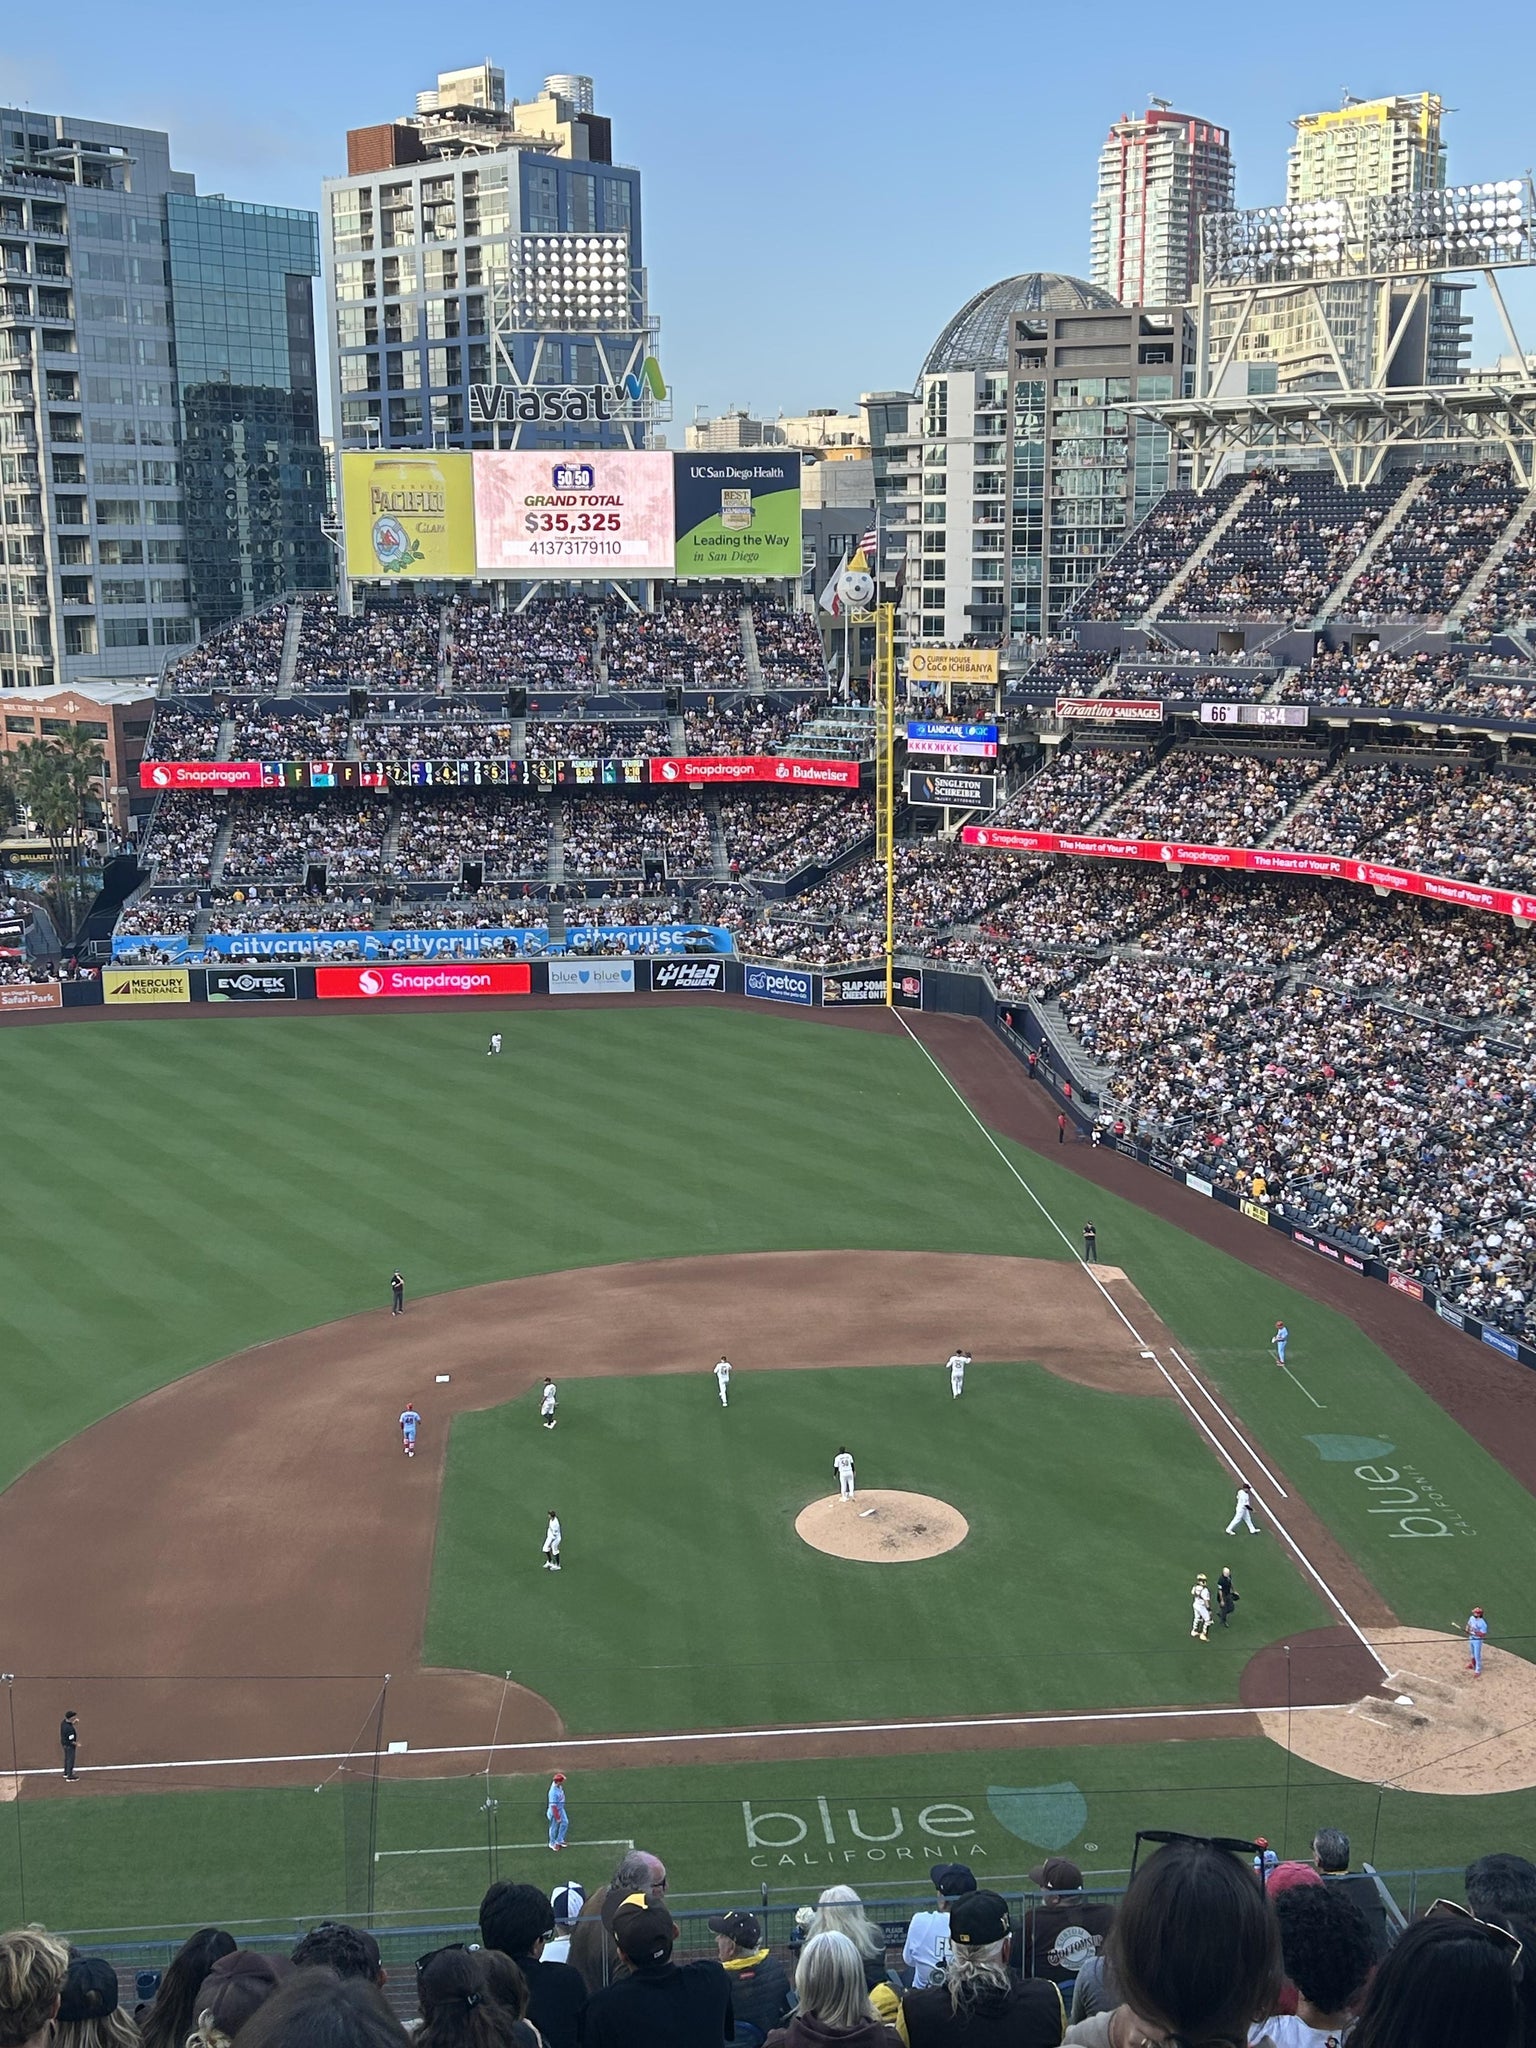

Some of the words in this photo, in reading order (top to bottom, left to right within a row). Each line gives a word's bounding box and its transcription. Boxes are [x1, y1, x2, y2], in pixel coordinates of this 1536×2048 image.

[474, 384, 611, 421] Viasat
[690, 466, 706, 478] UC
[707, 467, 725, 478] San
[726, 467, 752, 480] Diego
[753, 467, 784, 478] Health
[524, 496, 577, 506] GRAND
[580, 496, 624, 506] TOTAL
[724, 491, 748, 500] BEST
[525, 512, 621, 534] $35,325
[529, 541, 622, 555] 41373179110
[694, 535, 741, 548] Leading
[743, 535, 762, 545] the
[764, 534, 790, 548] Way
[694, 552, 704, 562] in
[708, 551, 727, 561] San
[731, 551, 760, 563] Diego
[927, 663, 947, 671] CoCo
[948, 664, 992, 672] ICHIBANYA
[1058, 700, 1114, 717] Tarantino
[1114, 708, 1160, 718] SAUSAGES
[1257, 708, 1286, 724] 6:34
[928, 726, 963, 736] LANDCARE
[966, 726, 988, 736] LOGIC
[345, 768, 352, 780] F
[394, 768, 400, 780] 7
[474, 762, 480, 772] 2
[684, 764, 754, 777] Snapdragon
[792, 766, 848, 782] Budweiser
[176, 769, 250, 782] Snapdragon
[296, 769, 302, 780] F
[934, 778, 981, 789] SINGLETON
[934, 786, 981, 798] SCHREIBER
[992, 834, 1038, 846] Snapdragon
[1059, 840, 1074, 849] The
[1074, 842, 1096, 851] Heart
[1098, 844, 1106, 852] of
[1106, 845, 1125, 853] Your
[1126, 846, 1138, 854] PC
[1178, 849, 1230, 864] Snapdragon
[1254, 856, 1272, 866] The
[1274, 858, 1298, 868] Heart
[1298, 860, 1308, 869] of
[1308, 860, 1330, 870] Your
[1330, 862, 1340, 872] PC
[1368, 868, 1408, 886] Snapdragon
[1425, 882, 1438, 892] The
[1438, 885, 1457, 897] Heart
[1458, 888, 1465, 898] of
[1465, 890, 1481, 902] Your
[1482, 894, 1492, 904] PC
[552, 971, 578, 981] blue
[594, 970, 620, 980] blue
[678, 964, 720, 978] H2O
[132, 979, 182, 987] MERCURY
[218, 974, 284, 991] EVOTEK
[392, 972, 490, 990] Snapdragon
[766, 975, 806, 992] petco
[842, 980, 863, 990] SLAP
[864, 980, 887, 990] SOME
[2, 995, 30, 1004] Safari
[31, 994, 54, 1003] Park
[842, 991, 868, 1000] CHEESE
[868, 991, 880, 999] ON
[880, 990, 888, 998] IT
[1354, 1465, 1454, 1538] blue
[1402, 1464, 1477, 1536] CALIFORNIA
[742, 1796, 976, 1848] blue
[750, 1843, 988, 1868] CALIFORNIA
[1056, 1928, 1084, 1946] CUSTOM
